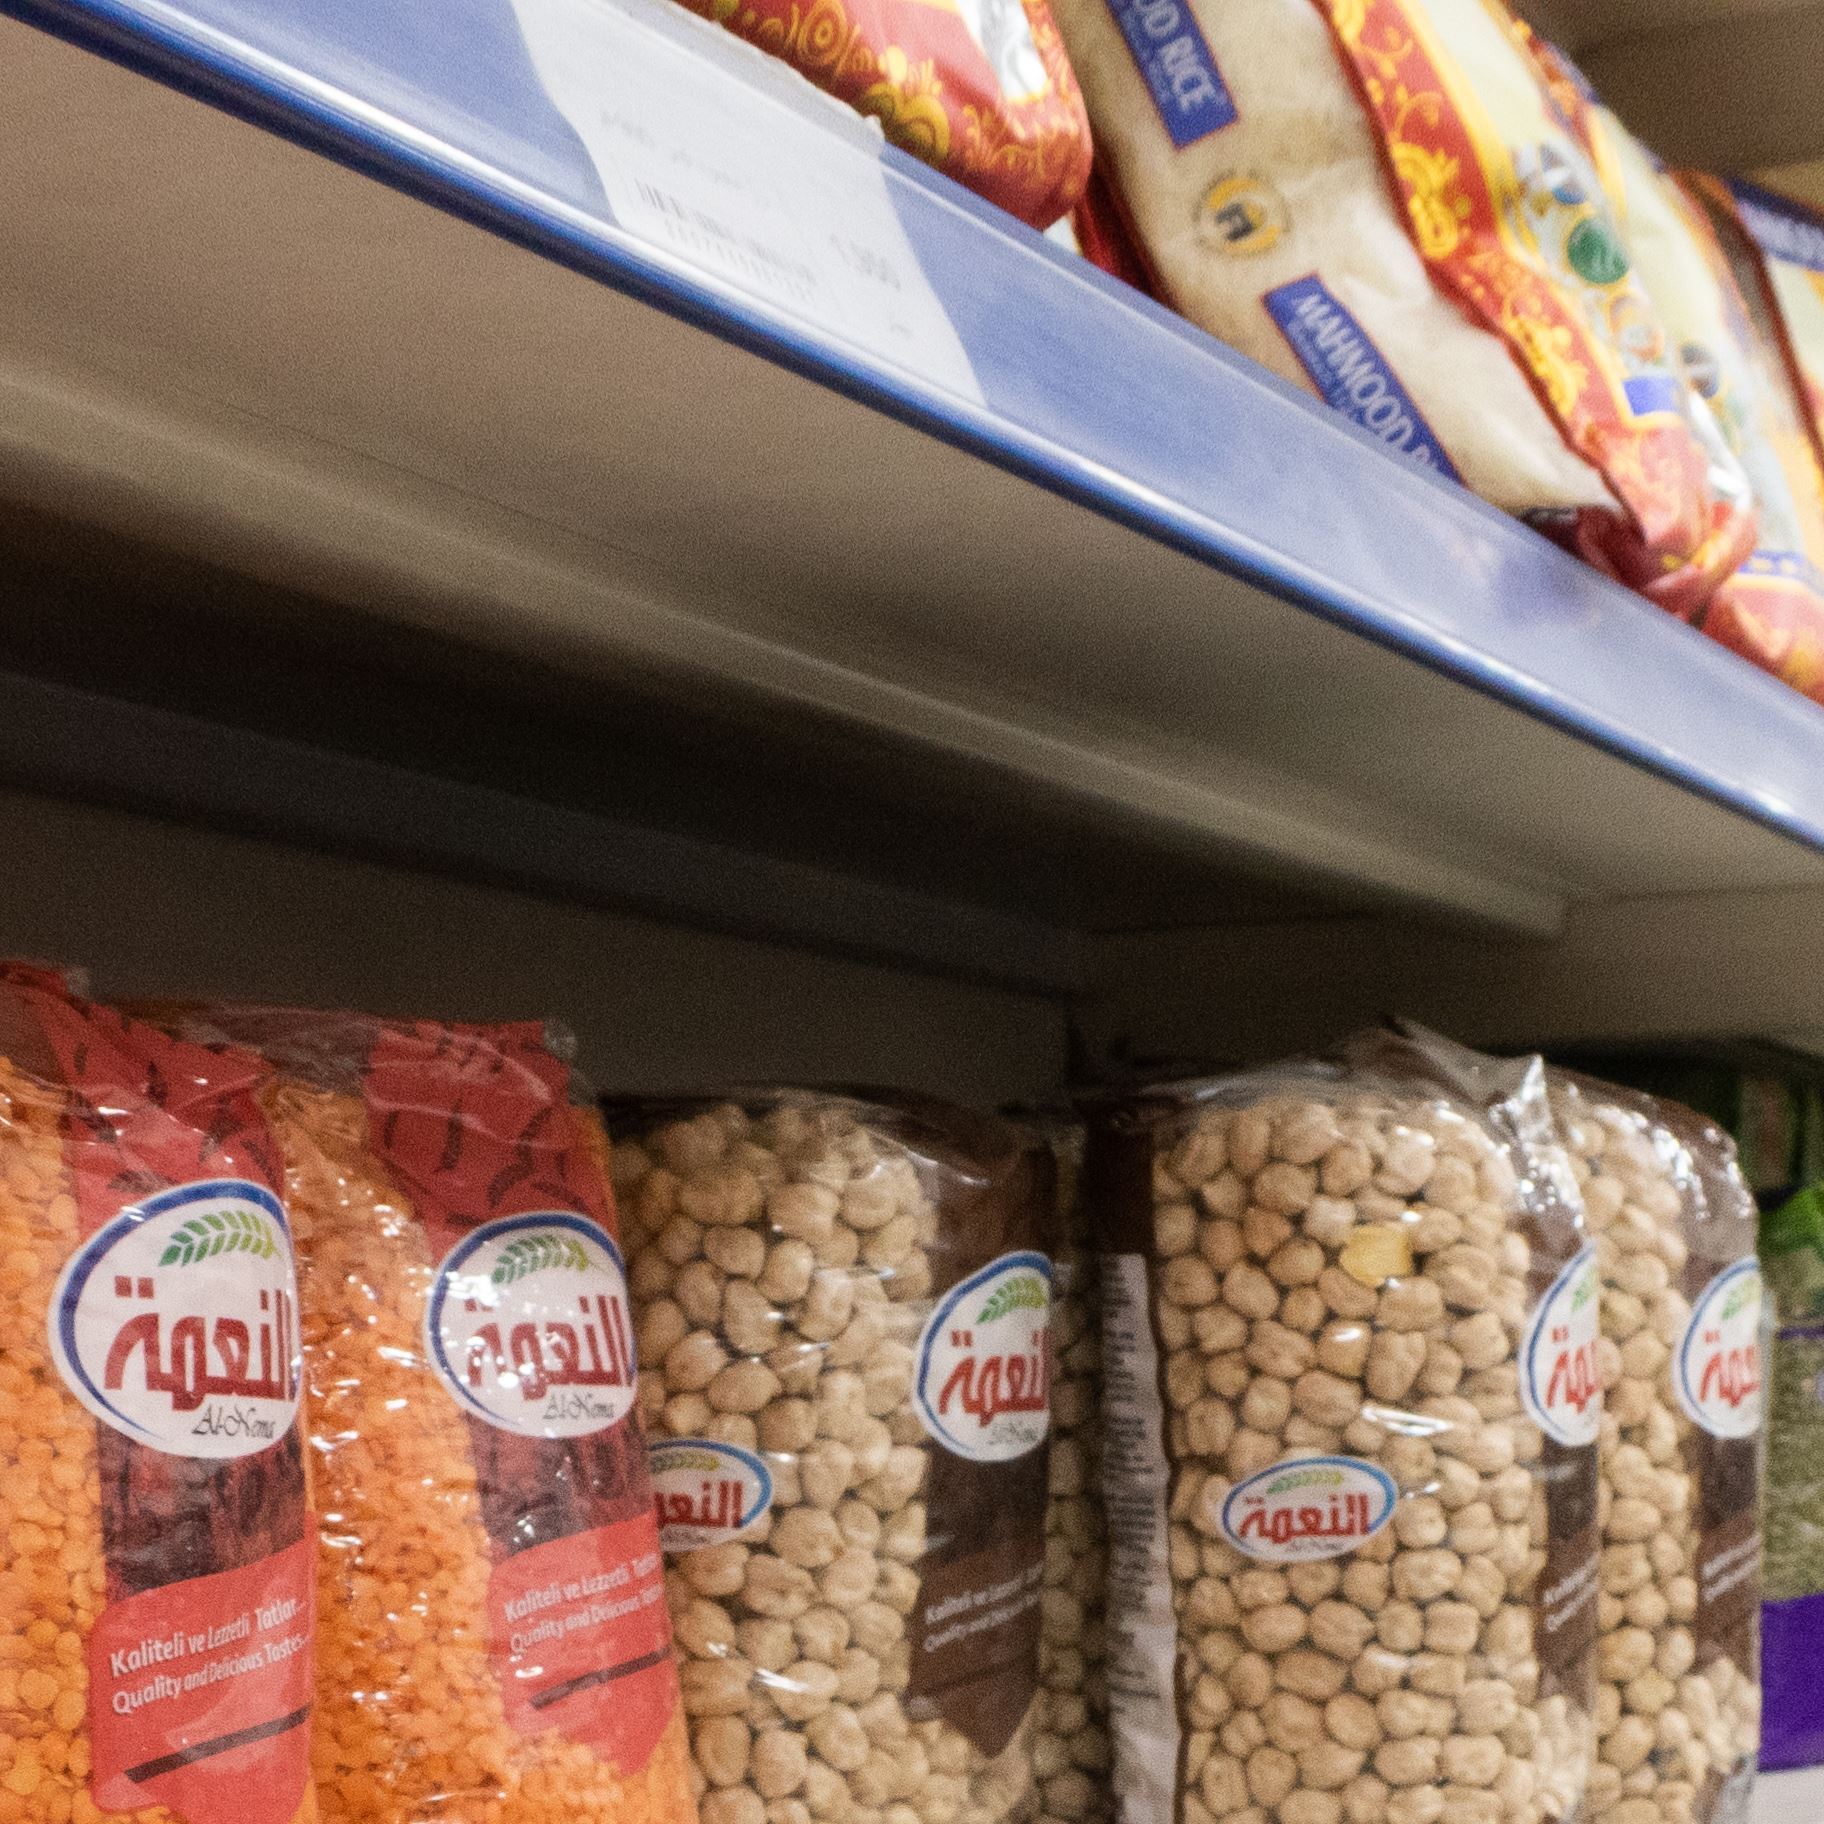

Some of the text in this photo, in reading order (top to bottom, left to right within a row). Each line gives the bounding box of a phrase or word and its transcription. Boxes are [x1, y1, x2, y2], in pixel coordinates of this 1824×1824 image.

[103, 1275, 297, 1411] النعمة
[1239, 1493, 1370, 1544] النعمة
[111, 1631, 184, 1678] Kaliteli
[188, 1633, 206, 1653] ve
[208, 1613, 250, 1649] Lezzetli
[112, 1675, 182, 1715] Quality
[184, 1664, 208, 1690] and
[210, 1651, 263, 1683] Delicious
